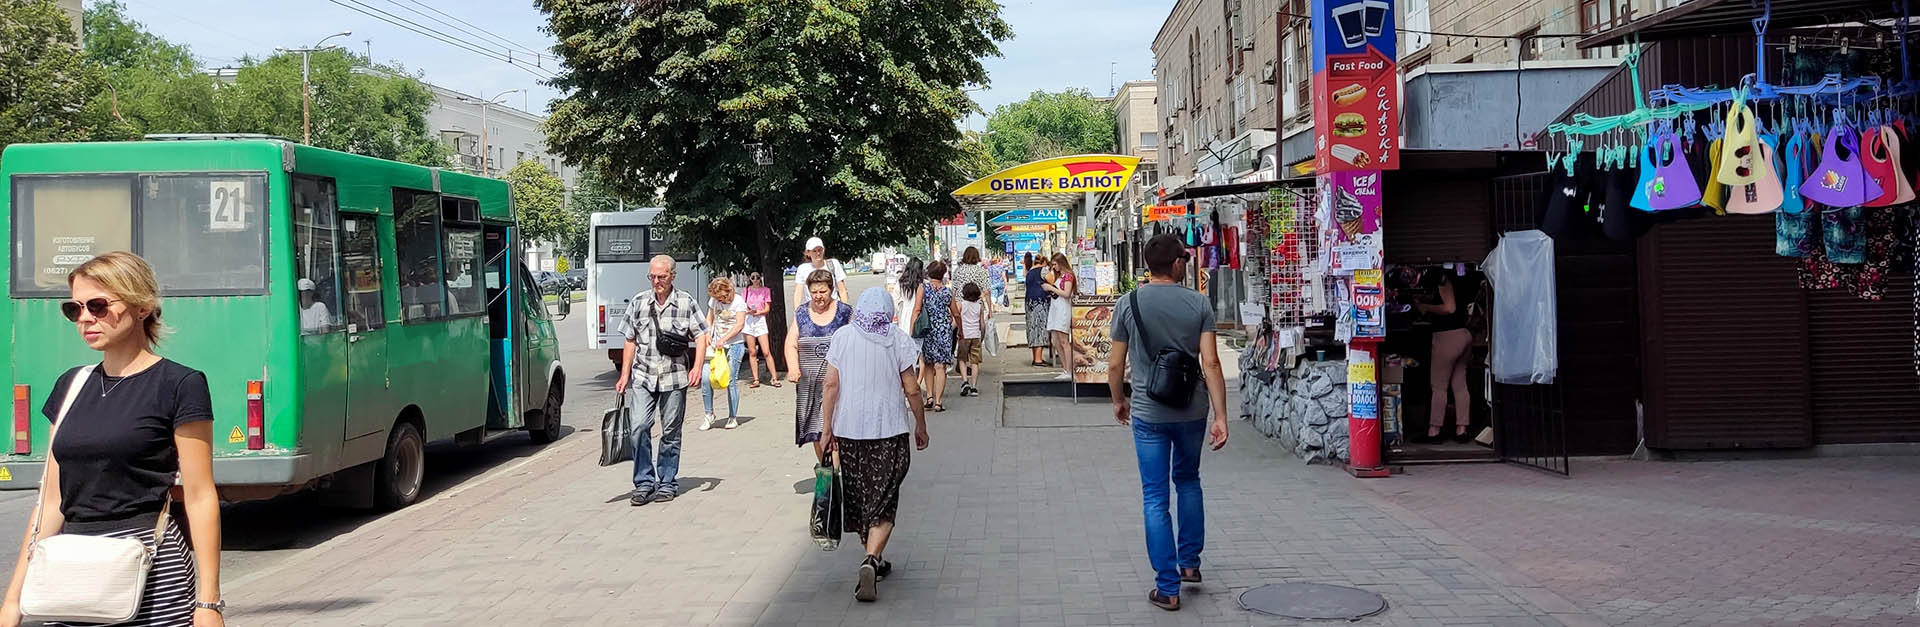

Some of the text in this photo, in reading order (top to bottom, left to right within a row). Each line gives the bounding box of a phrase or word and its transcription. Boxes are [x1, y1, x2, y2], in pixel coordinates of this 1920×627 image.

[1333, 60, 1384, 71] Fast Food
[1377, 86, 1392, 163] СКАЗКА
[990, 175, 1123, 191] ОБМЕН ВАЛЮТ
[1353, 176, 1368, 187] ICE
[215, 187, 240, 222] 21
[1032, 208, 1057, 217] TAXI
